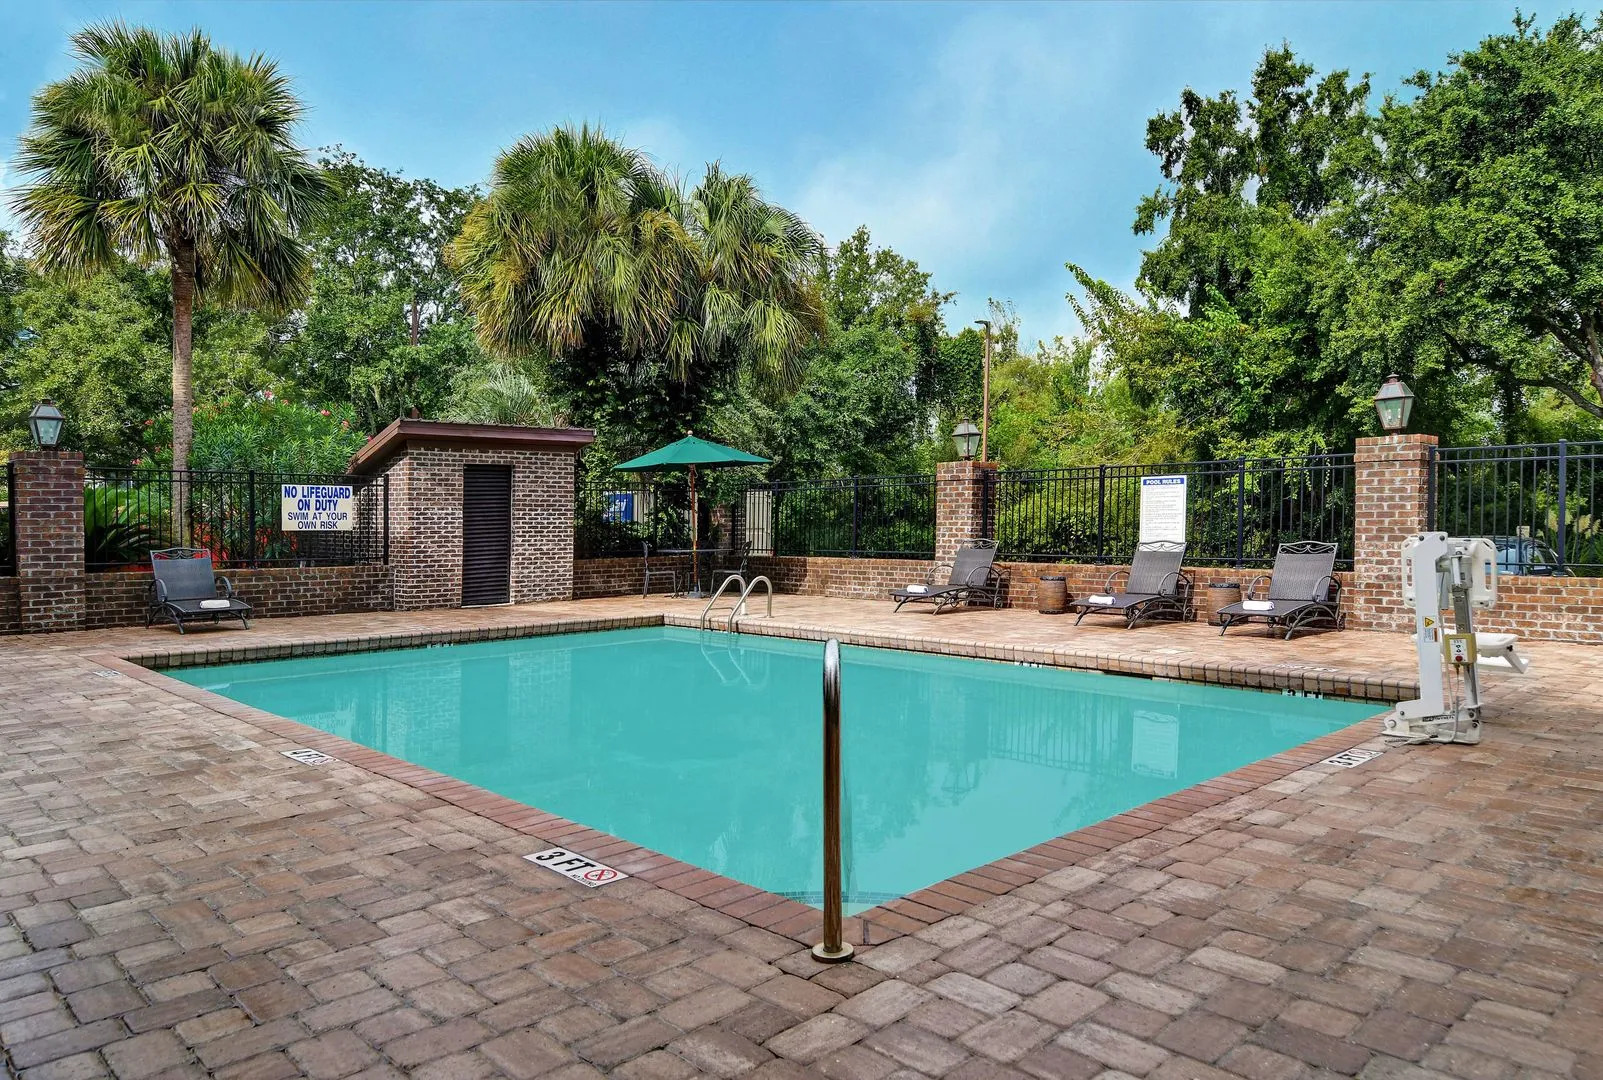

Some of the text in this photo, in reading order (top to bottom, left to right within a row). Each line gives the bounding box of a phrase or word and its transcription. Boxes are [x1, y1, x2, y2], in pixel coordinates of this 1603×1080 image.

[284, 486, 351, 499] NO LIFEGUARD
[297, 499, 338, 511] ON DUTY
[287, 512, 348, 520] SWIM AT YOUR
[297, 521, 338, 529] OWN RISK
[1336, 753, 1368, 762] FT
[535, 851, 597, 872] 3 FT
